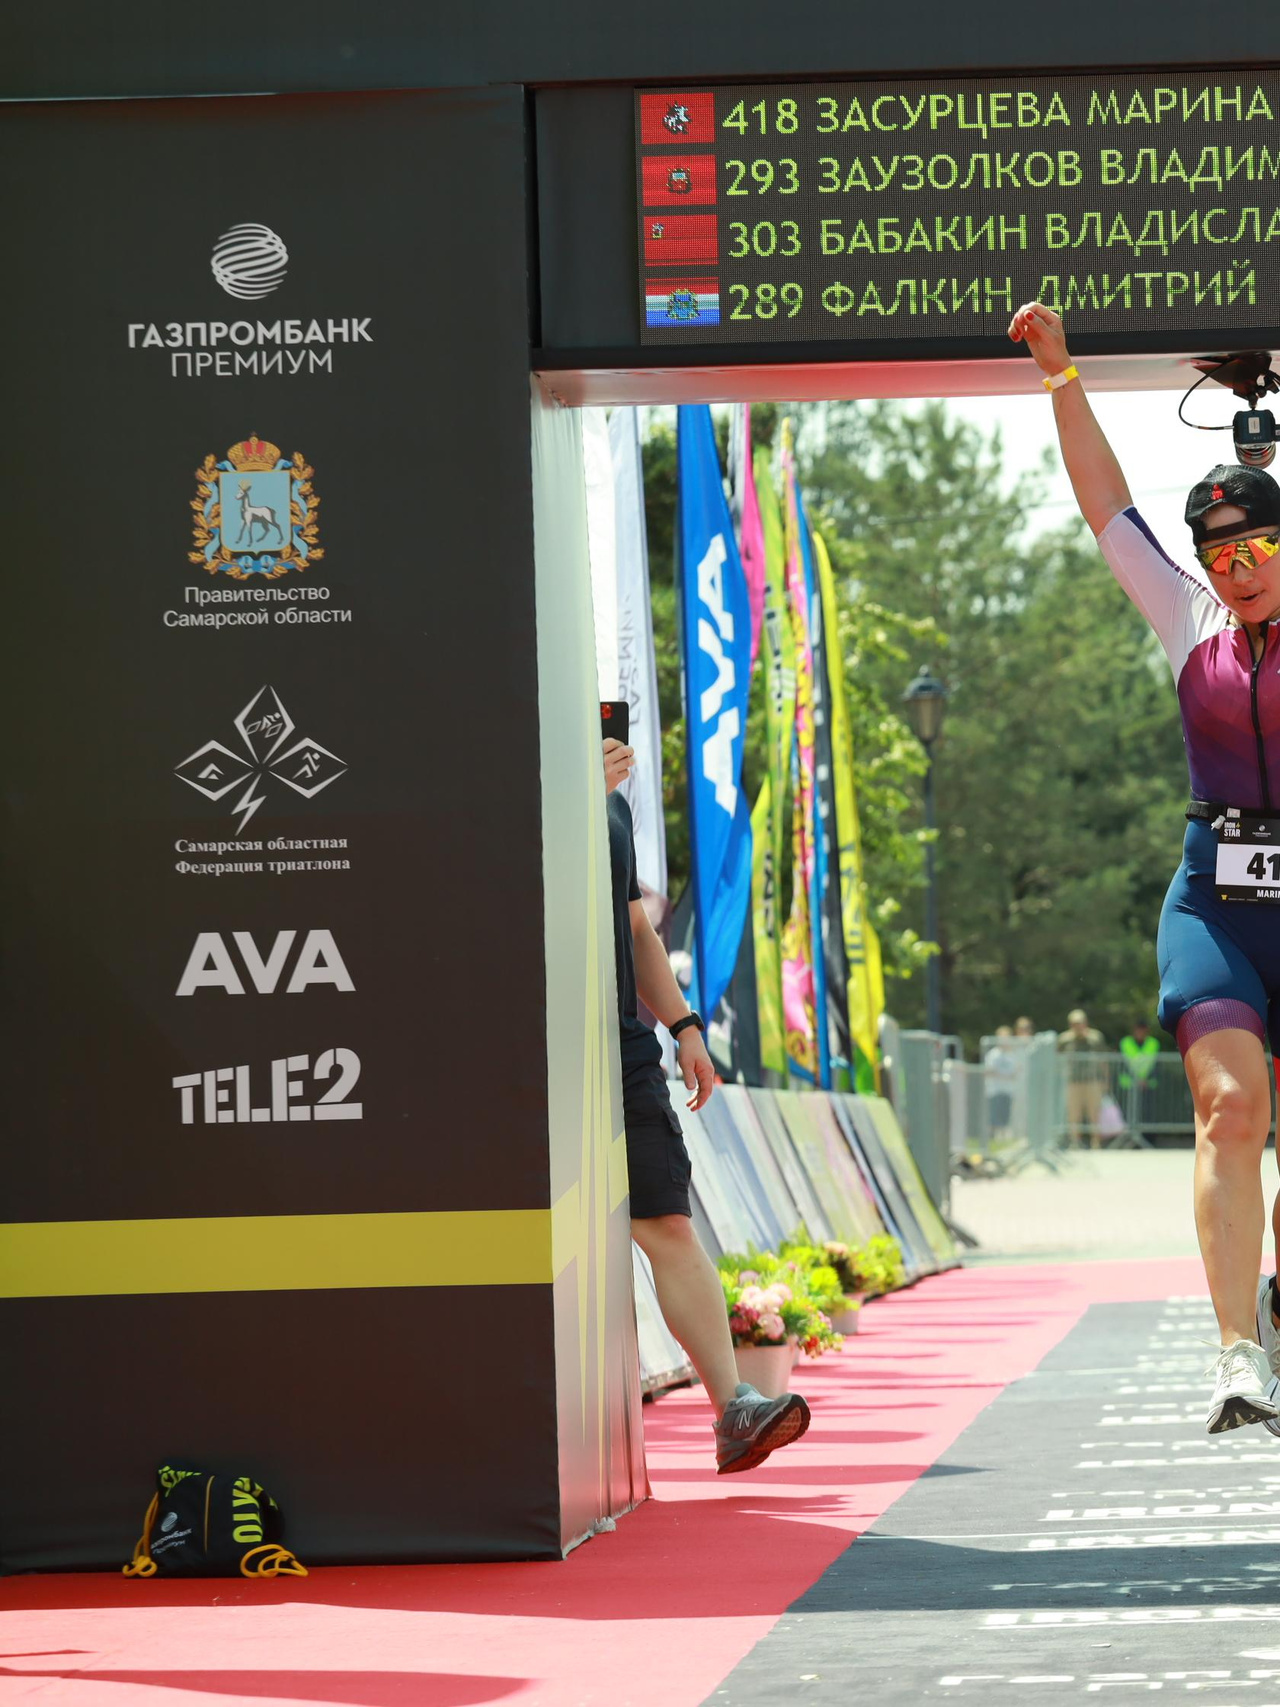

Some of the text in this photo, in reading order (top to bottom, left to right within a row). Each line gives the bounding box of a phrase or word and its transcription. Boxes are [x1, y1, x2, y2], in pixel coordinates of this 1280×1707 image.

[723, 86, 1273, 139] 418 ЗАСУРЦЕВА МАРИНА
[726, 159, 799, 195] 293
[818, 151, 1082, 192] ЗАУЗОЛКОВ
[728, 221, 801, 257] 303
[821, 215, 1026, 254] БАБАКИН
[729, 260, 1257, 319] 289 ФАЛКИН ДМИТРИЙ
[129, 318, 373, 348] ГАЗПРОМБАНК
[172, 350, 333, 377] ПРЕМИУМ
[185, 585, 330, 606] Правительство
[164, 607, 352, 630] Самарской области
[697, 533, 740, 819] AVA
[175, 837, 347, 855] Самарская областная
[1224, 828, 1241, 838] STAR
[175, 857, 350, 876] Федерация триатлона
[176, 930, 356, 996] AVA
[173, 1048, 362, 1124] TELE2
